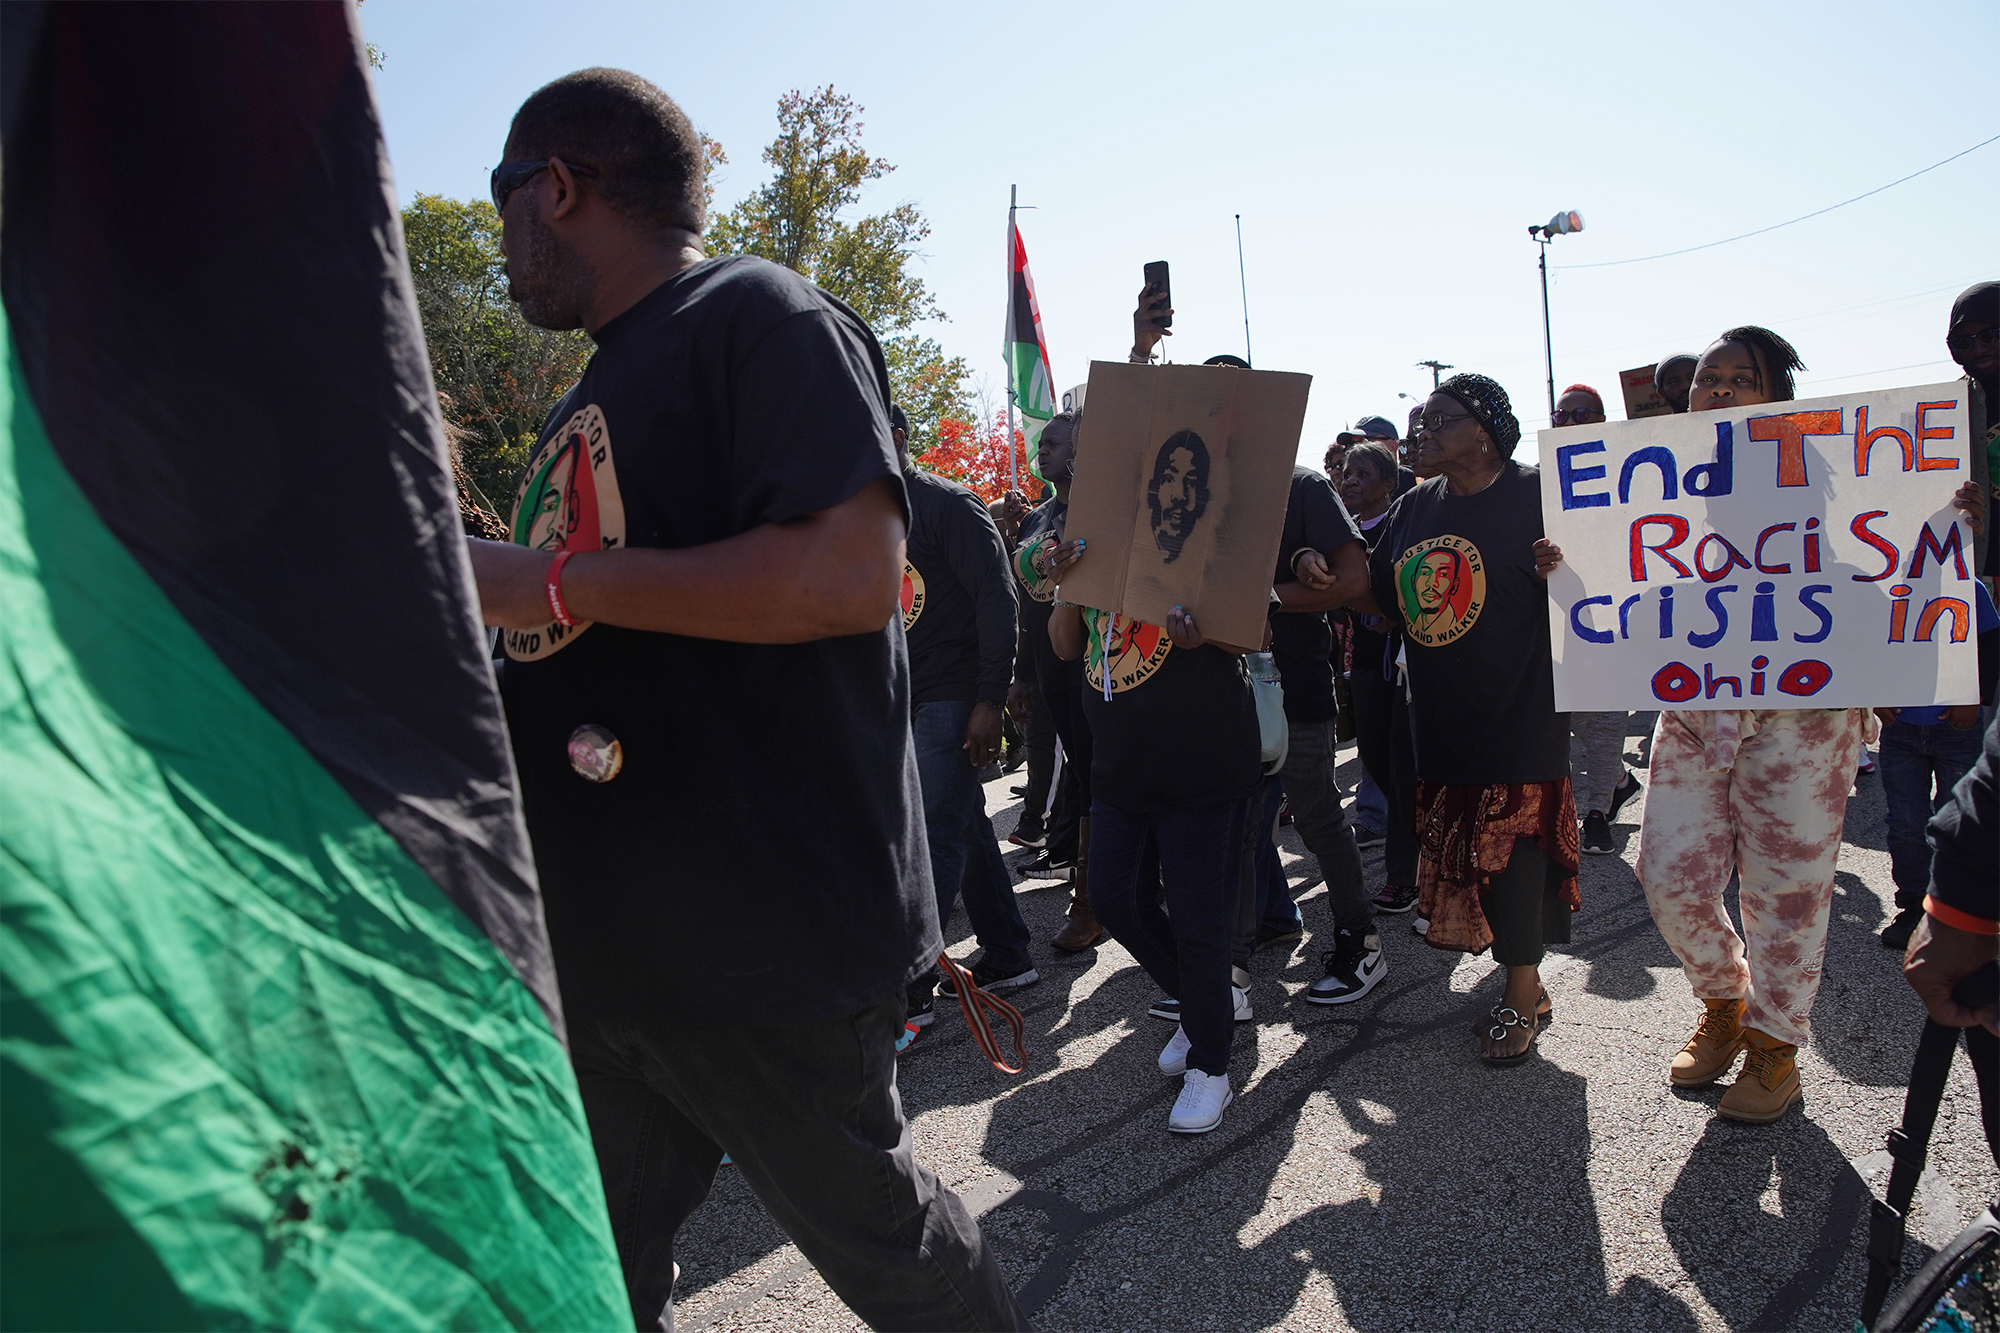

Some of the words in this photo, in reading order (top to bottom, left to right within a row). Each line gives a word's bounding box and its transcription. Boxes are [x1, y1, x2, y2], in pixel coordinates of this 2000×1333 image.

[1556, 421, 1733, 510] End
[1400, 537, 1462, 568] JUSTICE
[1464, 546, 1481, 574] FOR
[903, 593, 923, 629] ALKER
[1401, 605, 1433, 644] JYLAND
[1437, 601, 1480, 643] WALKER
[1888, 584, 1970, 644] in
[1084, 653, 1118, 690] JAYLAD
[1122, 637, 1170, 686] WALKER
